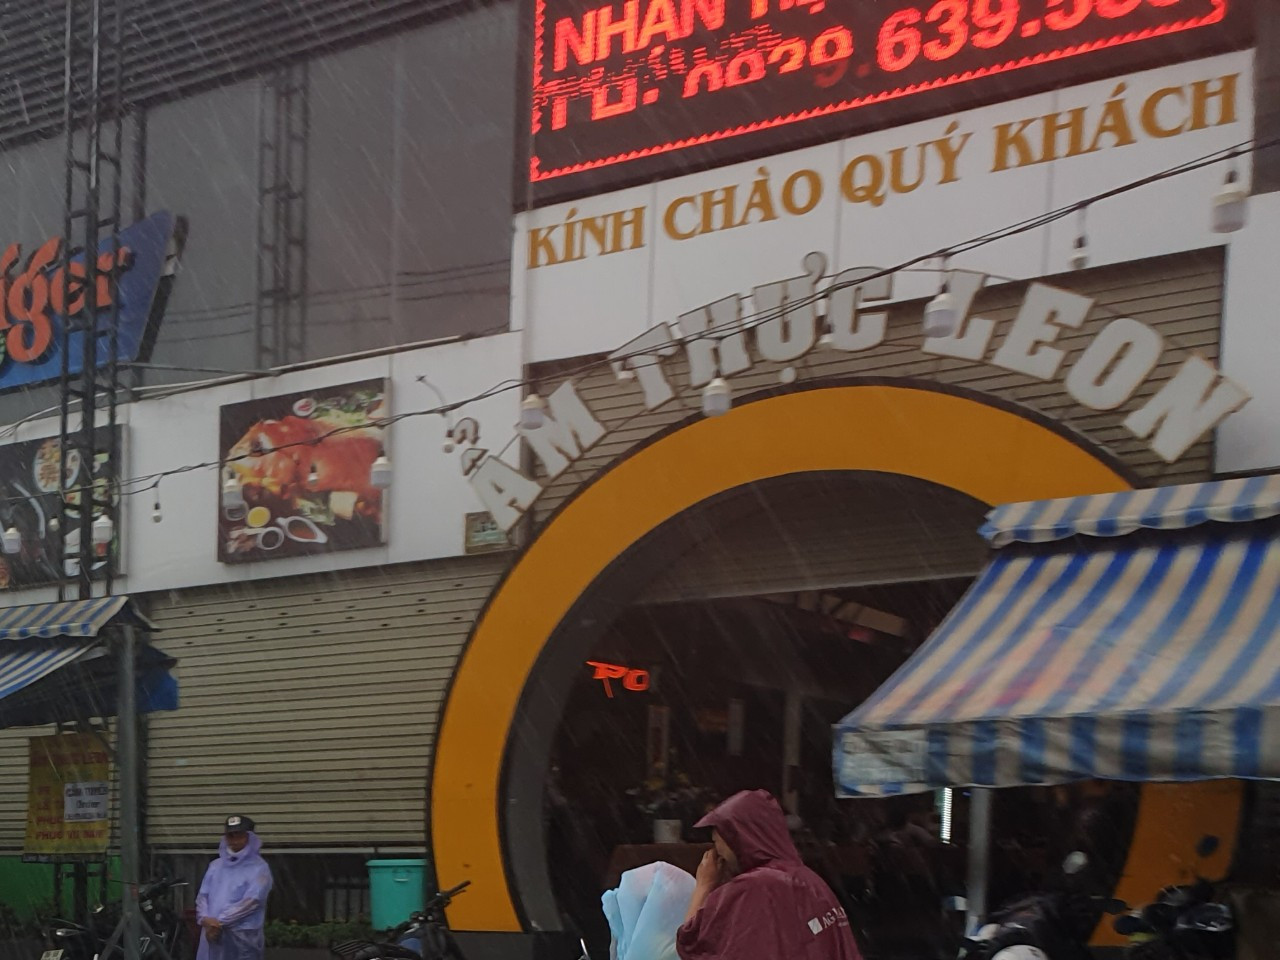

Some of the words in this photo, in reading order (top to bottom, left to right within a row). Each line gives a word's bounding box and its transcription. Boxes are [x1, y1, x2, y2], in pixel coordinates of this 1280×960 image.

[527, 199, 645, 270] KÍNH
[663, 166, 822, 241] CHÀO
[840, 121, 973, 207] QUÝ
[991, 73, 1240, 173] KHÁCH
[609, 251, 894, 412] THỰC
[920, 268, 1253, 464] LEON
